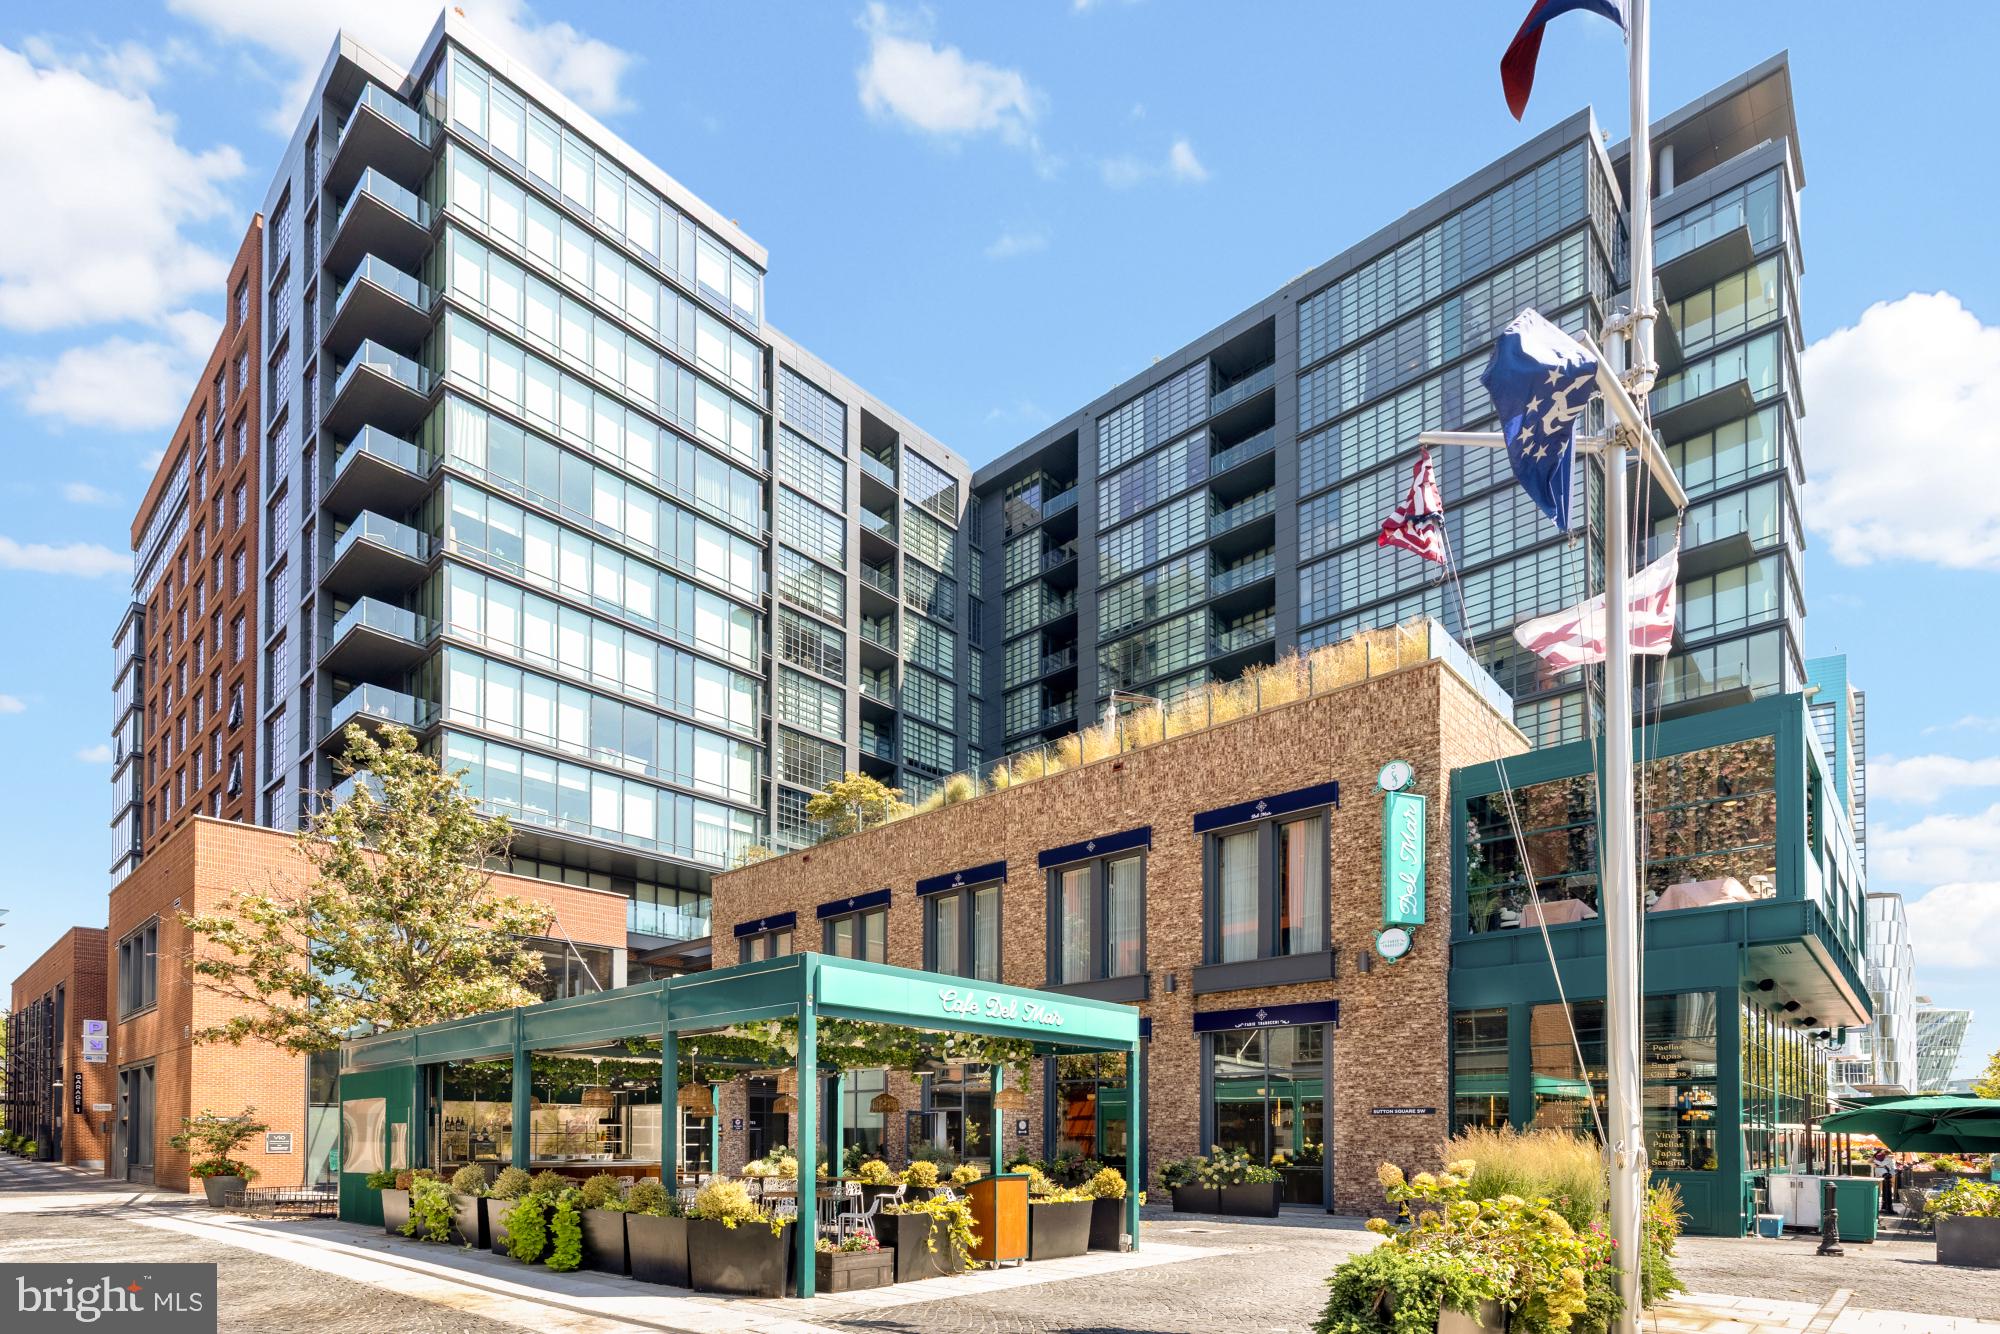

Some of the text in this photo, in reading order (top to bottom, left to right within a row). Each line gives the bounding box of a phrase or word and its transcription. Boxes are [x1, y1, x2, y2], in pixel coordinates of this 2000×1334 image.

[1398, 803, 1417, 916] Del Mar
[938, 989, 1065, 1026] Cafe Del Mar
[89, 1022, 103, 1034] P
[1652, 1043, 1684, 1051] Paellas
[1655, 1053, 1682, 1061] Tapas
[1655, 1150, 1682, 1158] Tapas
